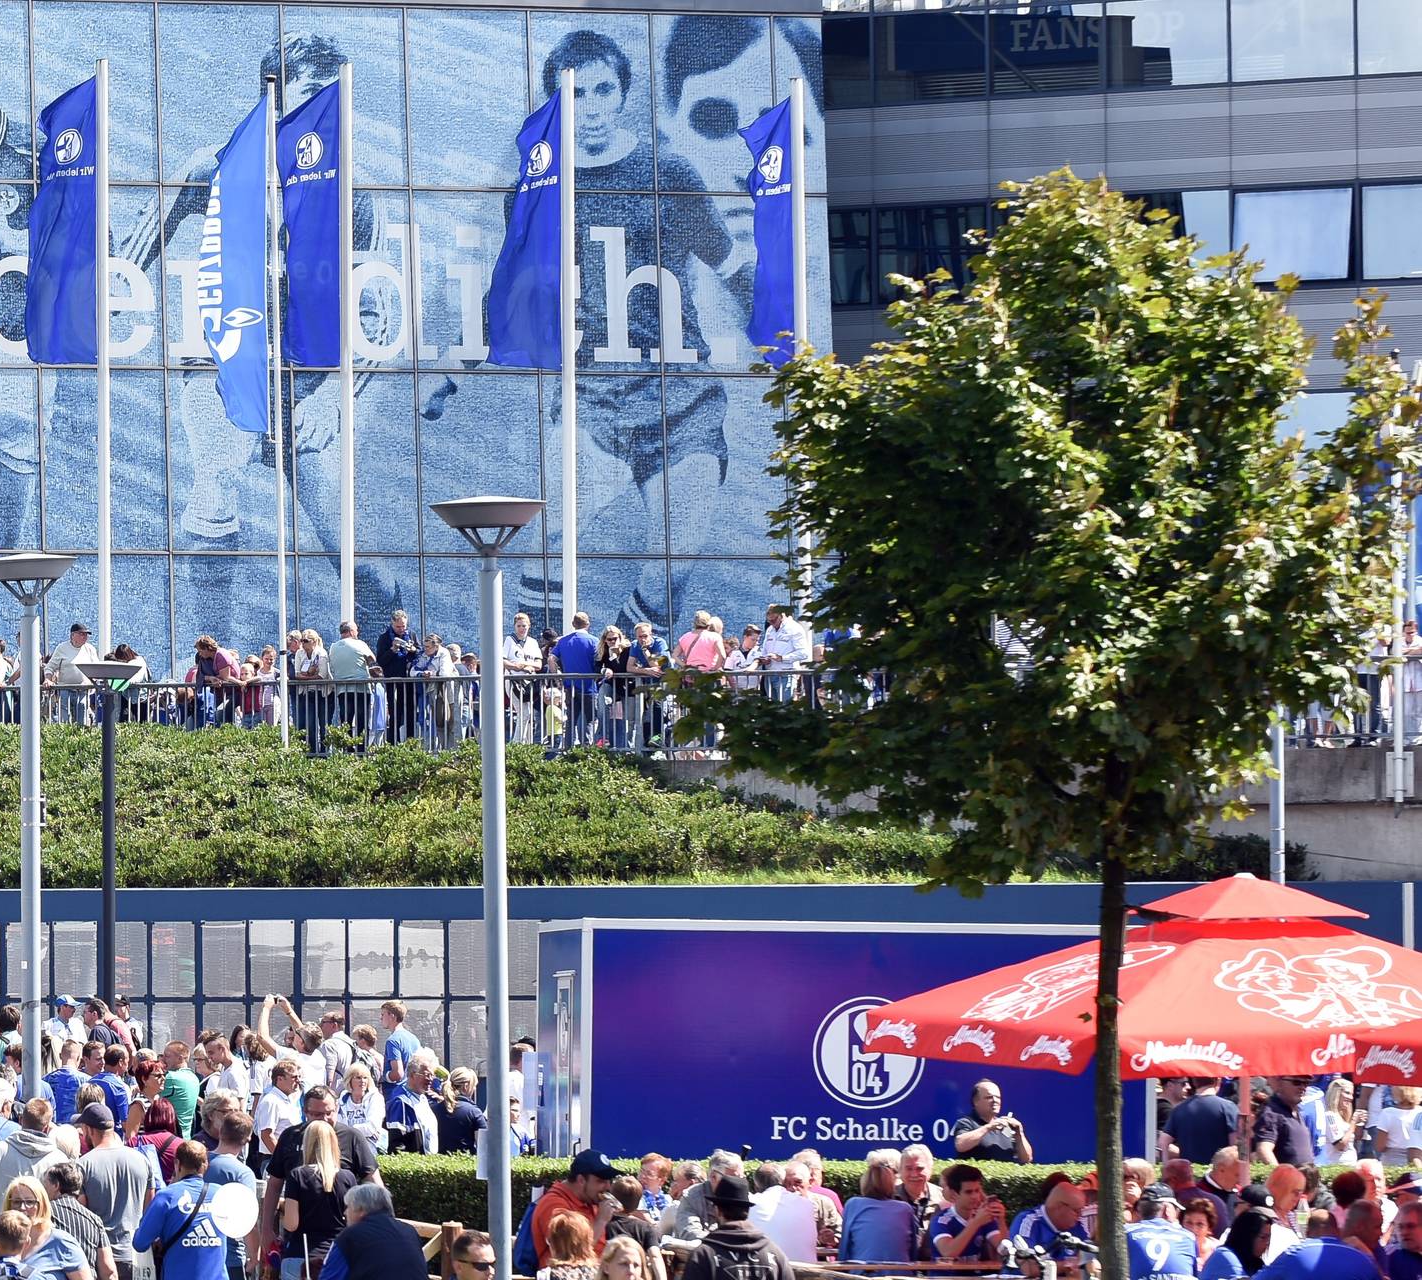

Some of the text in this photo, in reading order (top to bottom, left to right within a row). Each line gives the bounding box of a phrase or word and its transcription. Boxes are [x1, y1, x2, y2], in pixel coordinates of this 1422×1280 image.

[771, 1116, 955, 1142] FC Schalke 0
[182, 1236, 222, 1247] adidas
[1146, 1239, 1170, 1271] 9
